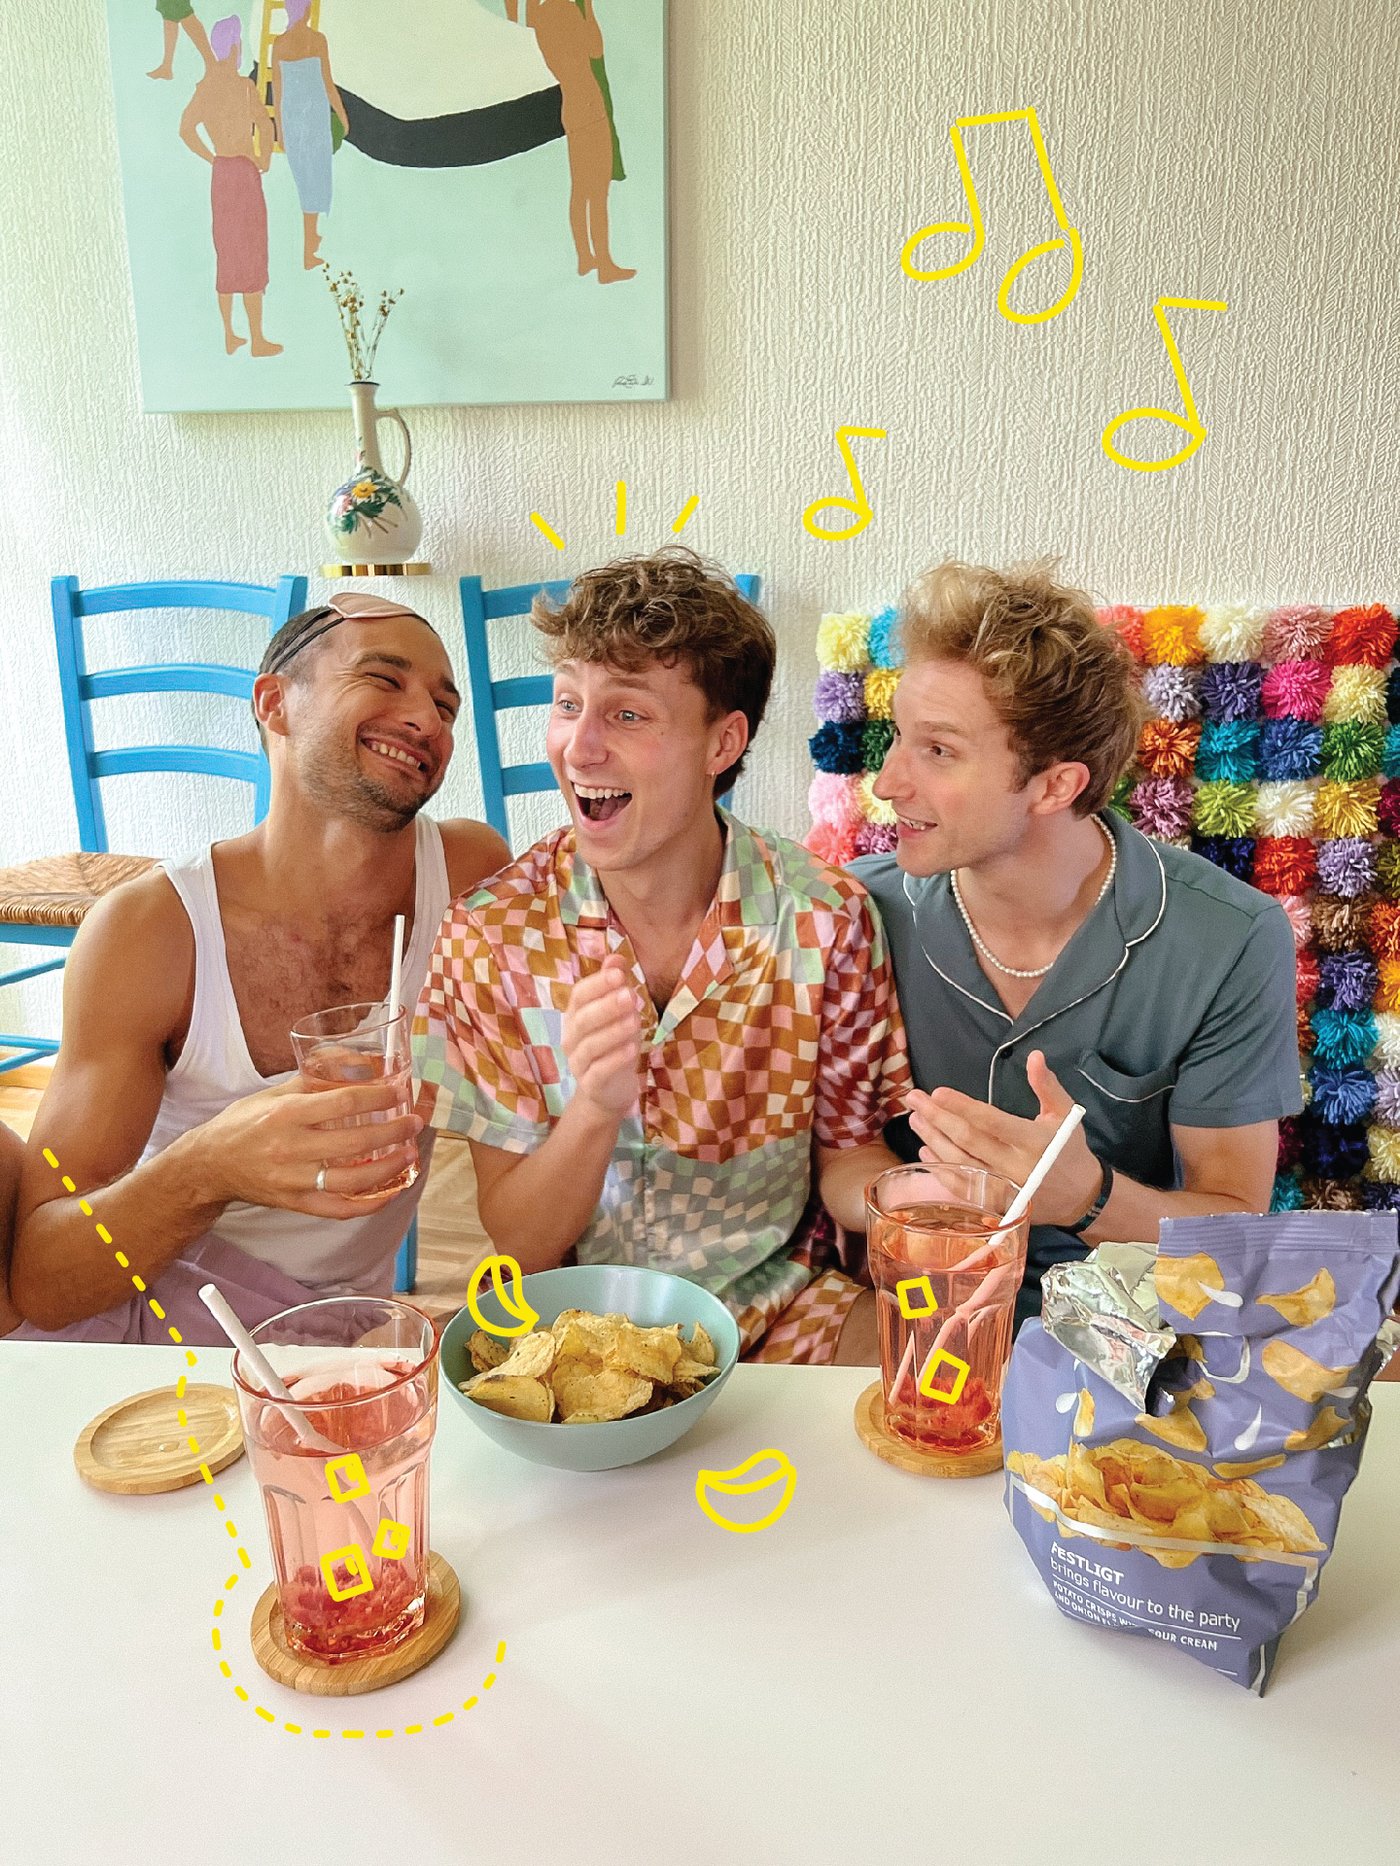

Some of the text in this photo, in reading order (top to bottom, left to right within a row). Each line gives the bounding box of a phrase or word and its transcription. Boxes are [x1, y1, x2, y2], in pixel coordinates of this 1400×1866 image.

[1051, 1541, 1125, 1585] FESTLIGT
[1050, 1556, 1241, 1632] brings flavour to the party
[1053, 1579, 1084, 1604] POTATO
[1085, 1599, 1117, 1623] CRISPS
[1180, 1635, 1218, 1651] CREAM
[1072, 1602, 1101, 1623] ONION
